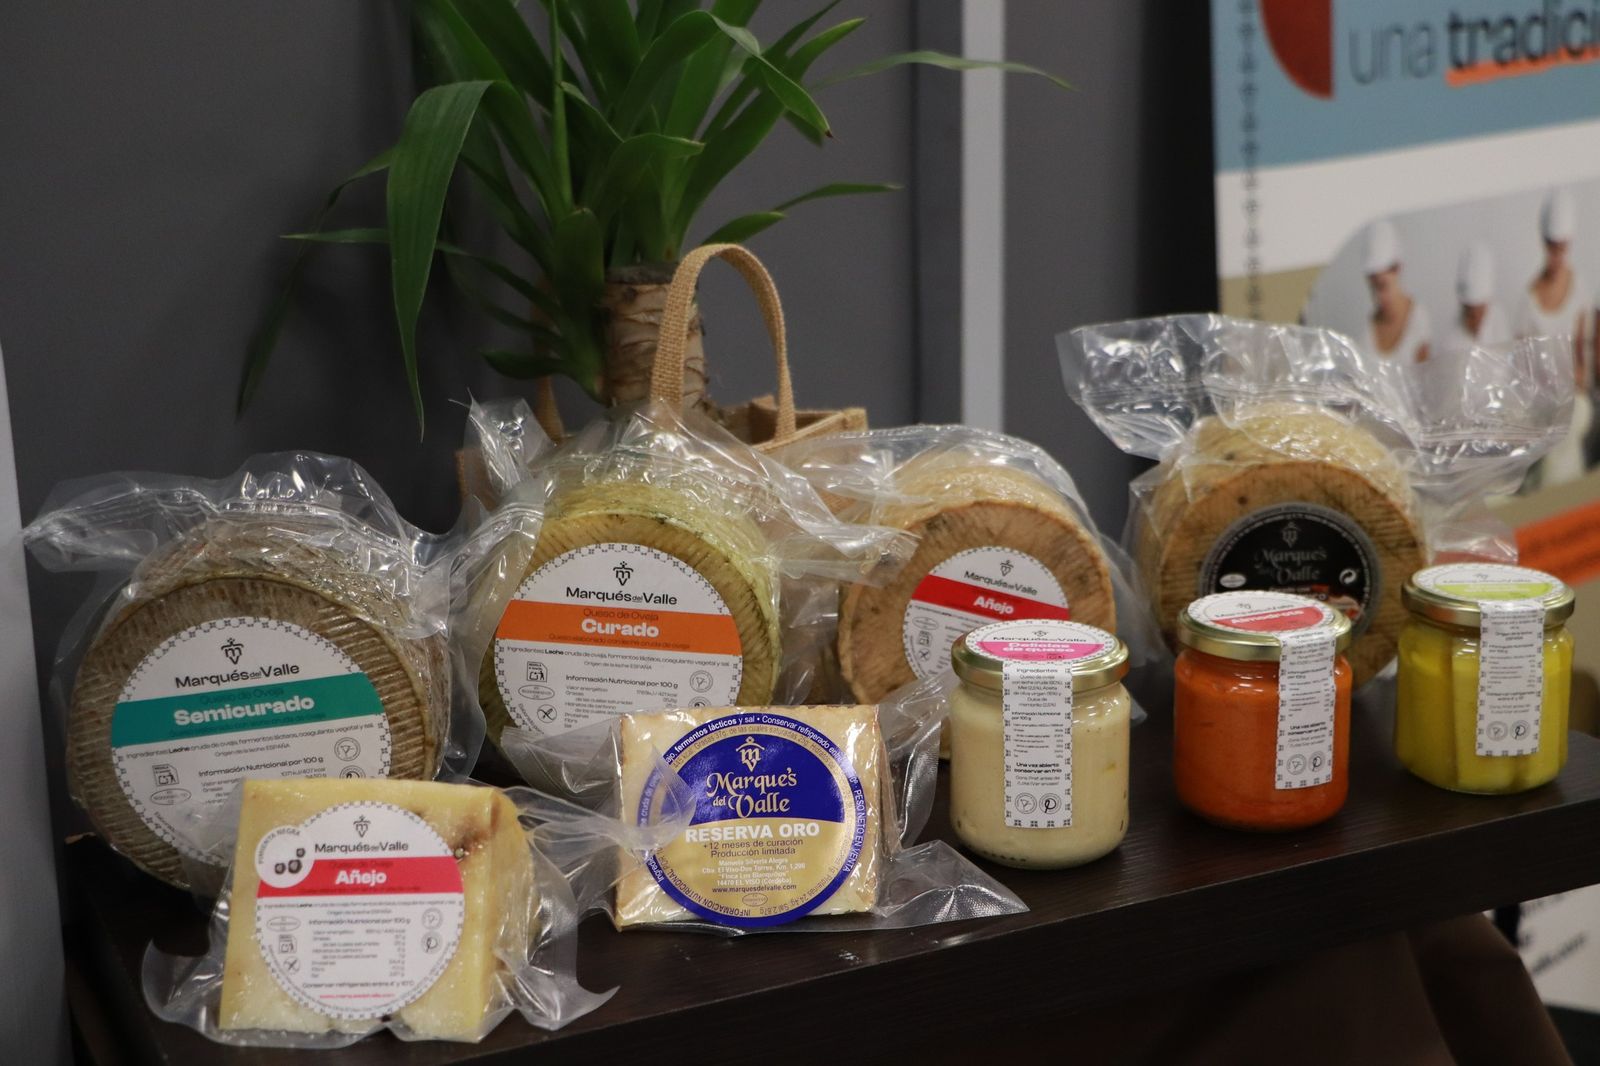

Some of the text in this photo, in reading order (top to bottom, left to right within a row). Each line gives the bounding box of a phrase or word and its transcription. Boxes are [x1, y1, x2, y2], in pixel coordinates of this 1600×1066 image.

[565, 586, 632, 603] Marqués
[642, 592, 678, 606] Valle
[1014, 582, 1038, 596] Valle
[583, 608, 615, 618] Queso
[617, 610, 630, 619] de
[972, 595, 1015, 614] Añejo
[581, 617, 660, 638] Curado
[175, 669, 250, 688] Marqués
[260, 663, 300, 678] Valle
[565, 674, 608, 683] Información
[609, 677, 646, 687] Nutricional
[646, 680, 660, 688] por
[174, 695, 315, 726] Semicurado
[706, 716, 737, 732] lácticos
[761, 714, 798, 730] Conservar
[672, 726, 708, 753] fermentos
[795, 723, 831, 750] refrigerado
[168, 746, 190, 754] Leche
[198, 765, 246, 777] Información
[246, 760, 288, 772] Nutricional
[288, 759, 302, 767] por
[712, 791, 791, 818] del Valle
[852, 788, 865, 811] PESO
[276, 827, 301, 836] NEGRA
[856, 812, 865, 833] NETO
[685, 822, 820, 843] RESERVA ORO
[853, 835, 863, 847] EN
[314, 840, 409, 854] Marqués Valle
[711, 846, 796, 859] Producción limitada
[721, 842, 751, 850] meses
[752, 840, 764, 848] de
[766, 838, 804, 848] curación
[841, 846, 860, 873] VENTA
[335, 869, 388, 886] Añejo
[664, 868, 703, 904] NUTRICIONAL
